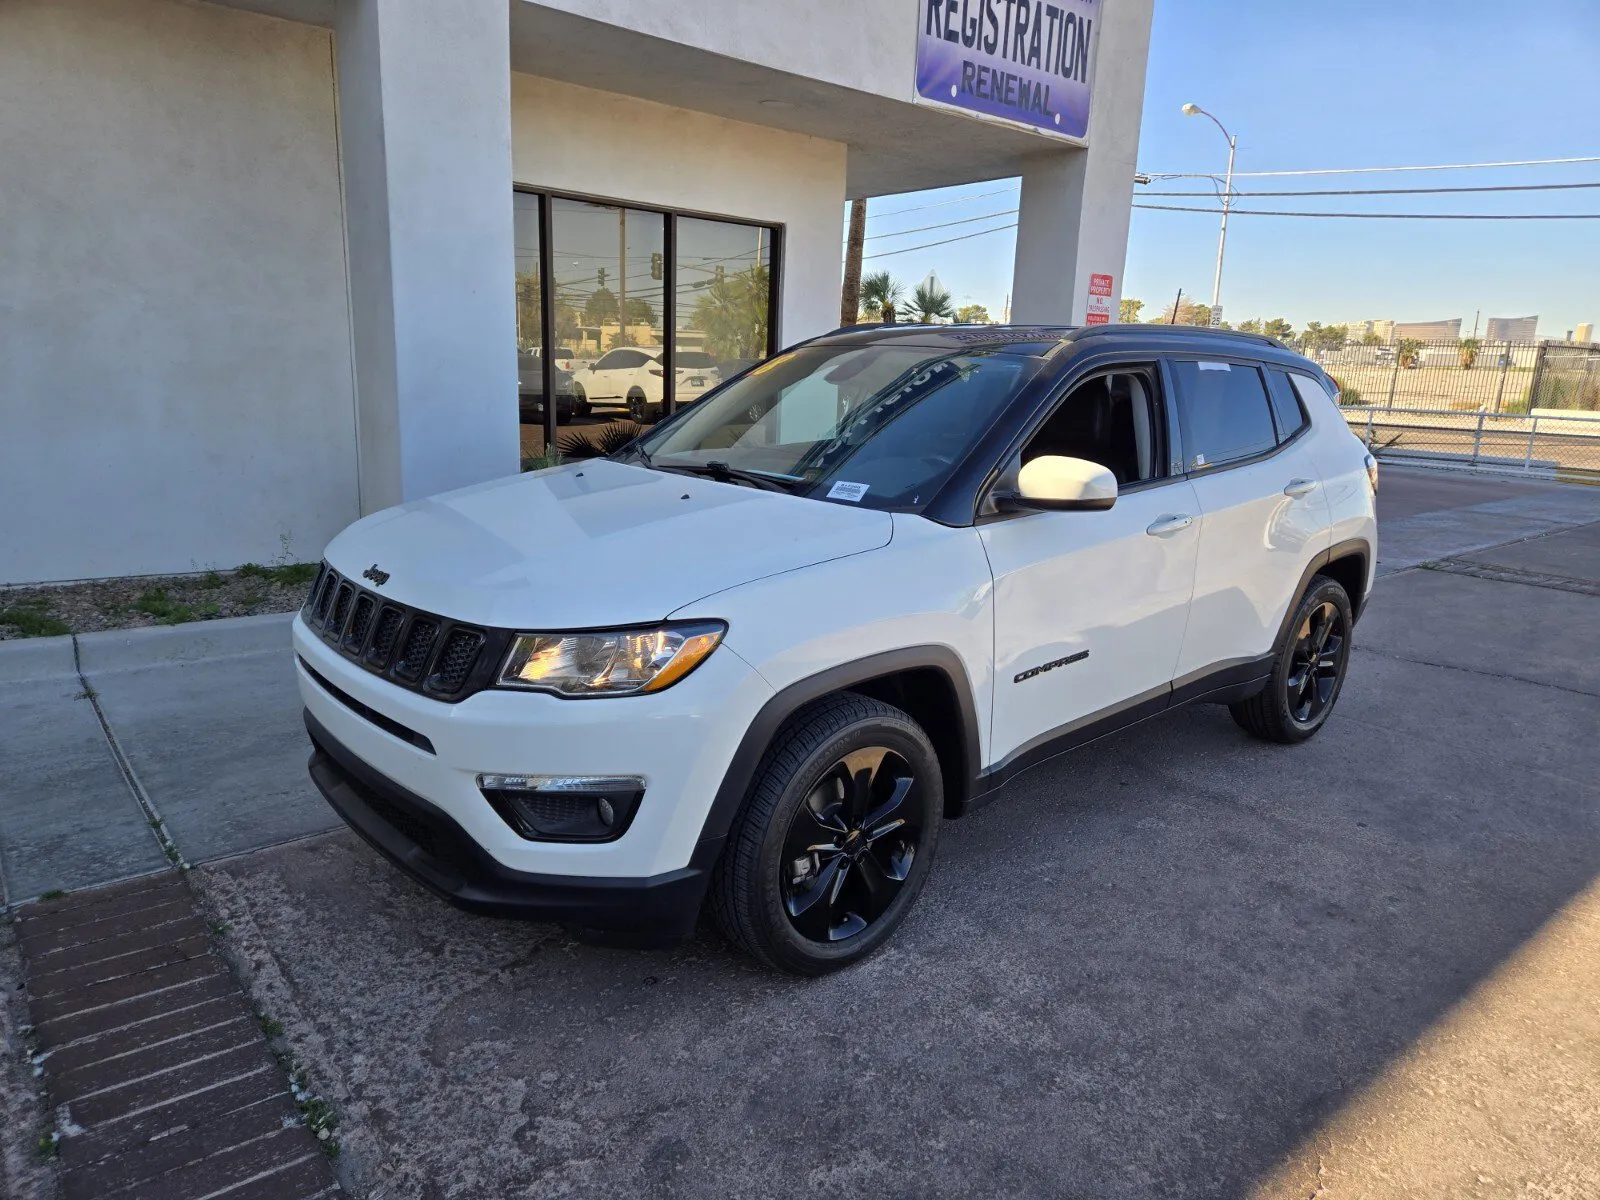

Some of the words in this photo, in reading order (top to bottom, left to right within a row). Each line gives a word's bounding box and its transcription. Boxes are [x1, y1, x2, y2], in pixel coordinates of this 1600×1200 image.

[926, 0, 1092, 84] REGISTRATION
[961, 60, 1055, 116] RENEWAL
[1090, 286, 1111, 295] PROPERTY
[1093, 278, 1110, 287] PRIVATE
[1211, 317, 1221, 325] 25
[363, 564, 390, 587] Jeep
[1014, 649, 1089, 683] COMPASS
